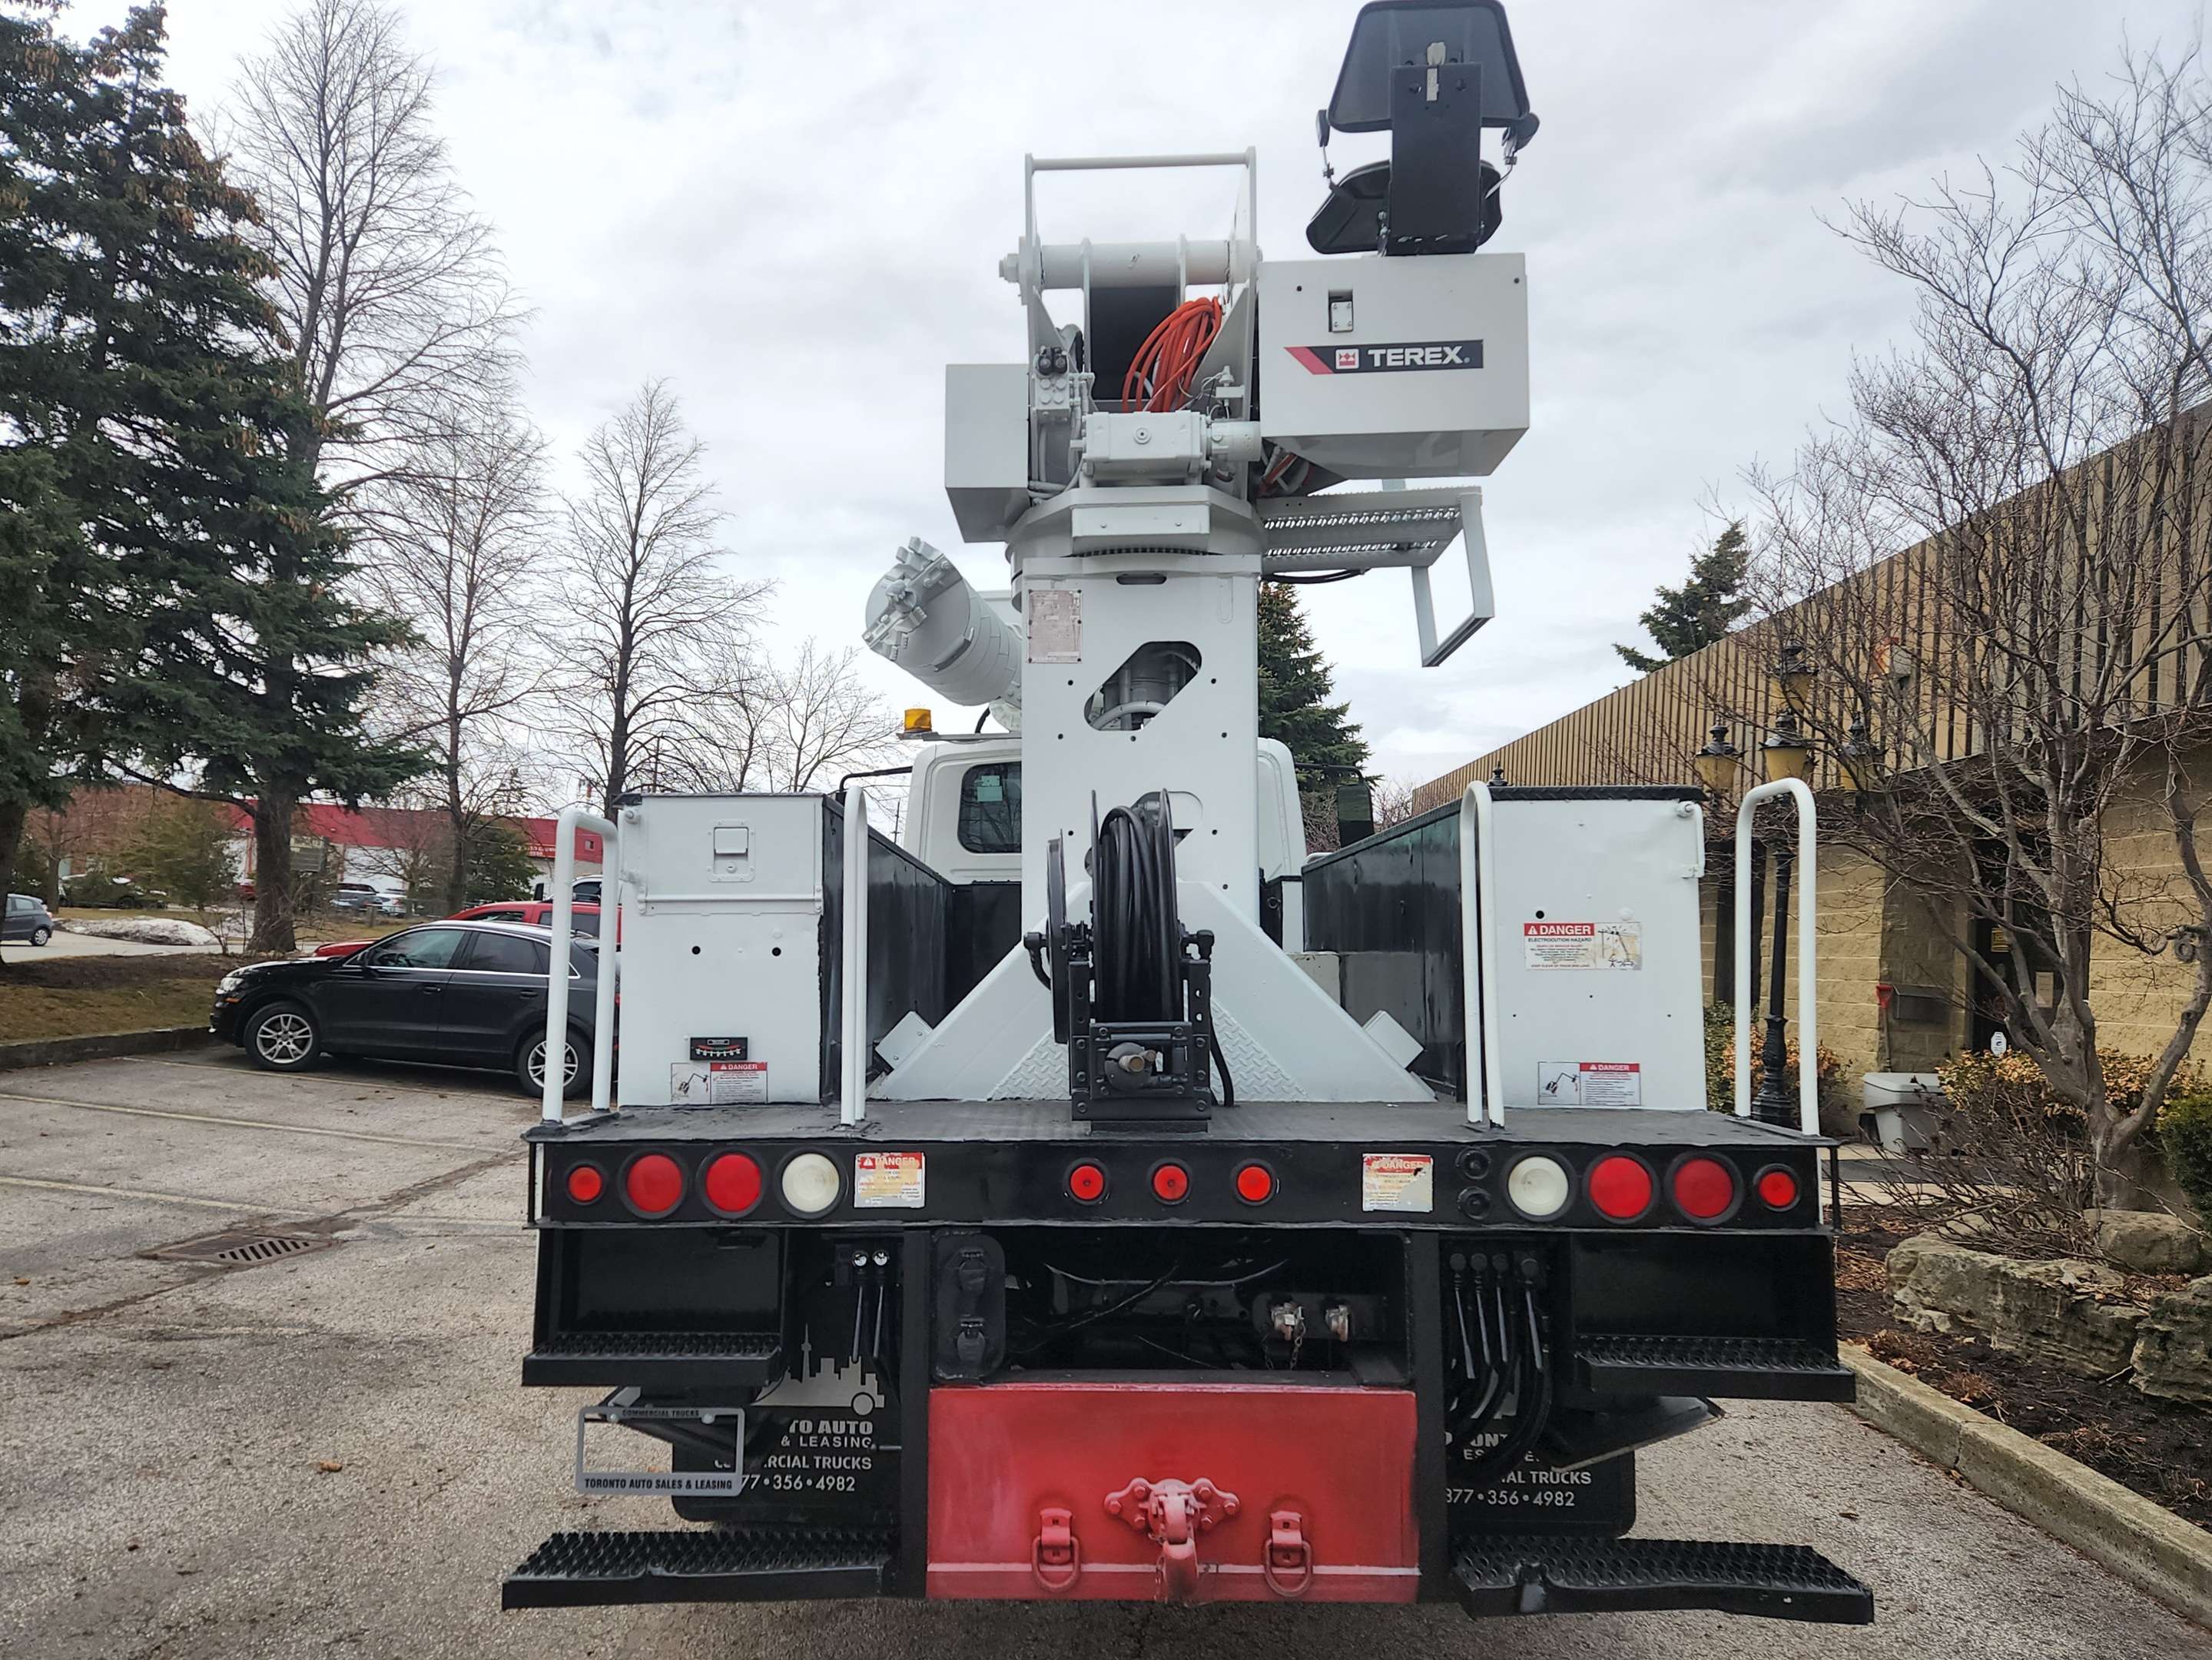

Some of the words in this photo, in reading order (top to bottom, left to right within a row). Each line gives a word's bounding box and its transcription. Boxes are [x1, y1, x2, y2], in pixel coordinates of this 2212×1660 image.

[1368, 346, 1463, 367] TEREX
[1540, 925, 1591, 935] DANGER
[817, 1420, 873, 1435] AUTO
[781, 1436, 790, 1446] &
[800, 1436, 872, 1449] LEASING
[813, 1456, 872, 1470] TRUCKS
[585, 1479, 625, 1489] TORONTO
[629, 1479, 651, 1489] AUTO
[655, 1479, 682, 1489] SALES
[685, 1479, 691, 1489] &
[695, 1479, 732, 1489] LEASING
[1530, 1471, 1592, 1485] TRUCKS
